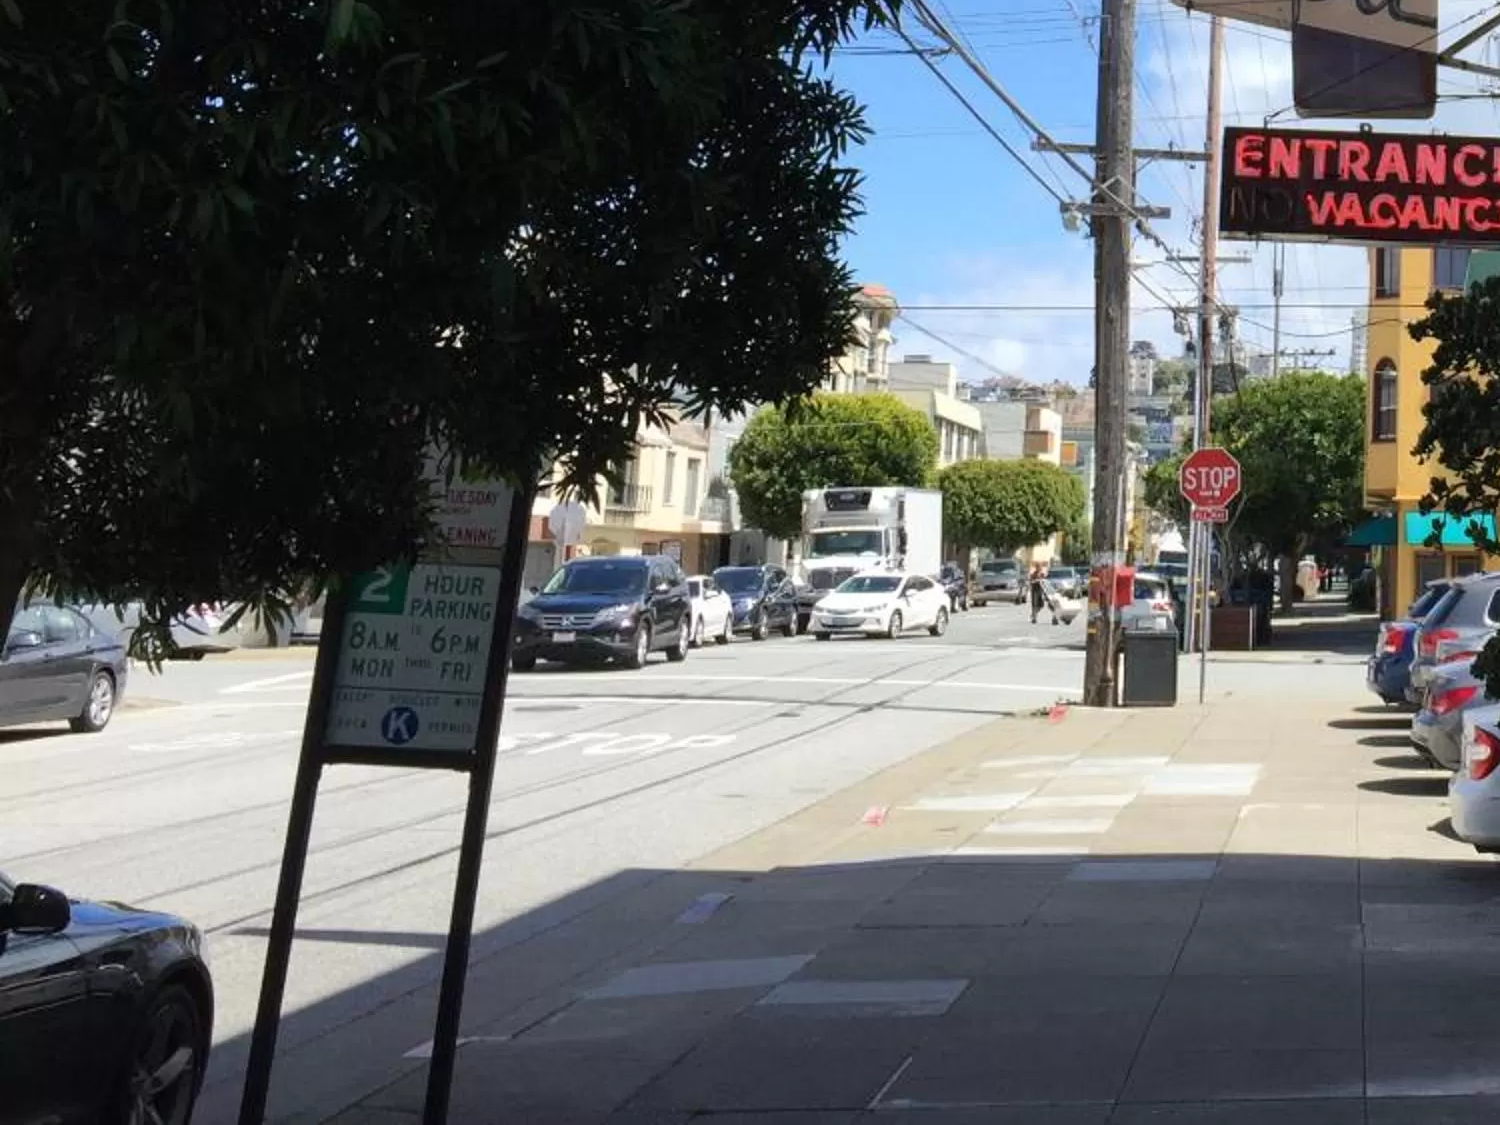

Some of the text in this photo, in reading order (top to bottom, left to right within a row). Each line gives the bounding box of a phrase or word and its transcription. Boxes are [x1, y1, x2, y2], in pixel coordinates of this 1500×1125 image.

[1184, 466, 1237, 490] STOP
[358, 564, 486, 603] 2 HOUR
[410, 598, 492, 622] PARKING
[351, 657, 396, 678] MON
[440, 661, 473, 683] FRI
[387, 710, 412, 741] K
